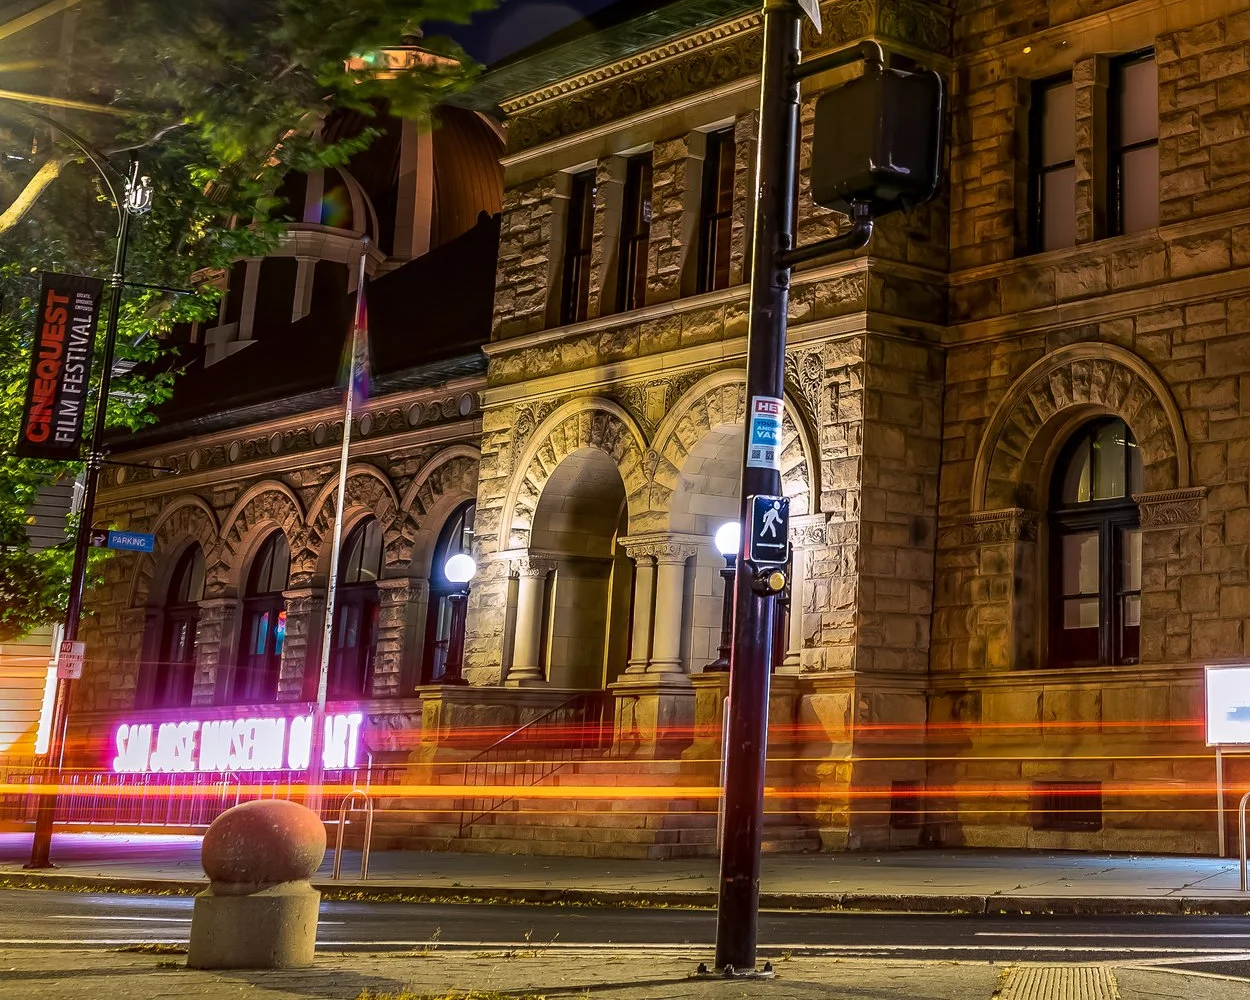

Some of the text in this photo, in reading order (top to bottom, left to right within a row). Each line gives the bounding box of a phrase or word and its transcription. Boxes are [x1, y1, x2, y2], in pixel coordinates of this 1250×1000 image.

[26, 289, 70, 443] CINEQUEST
[55, 314, 92, 443] FILM FESTIVAL
[112, 536, 146, 547] PARKING
[61, 643, 71, 652] NO
